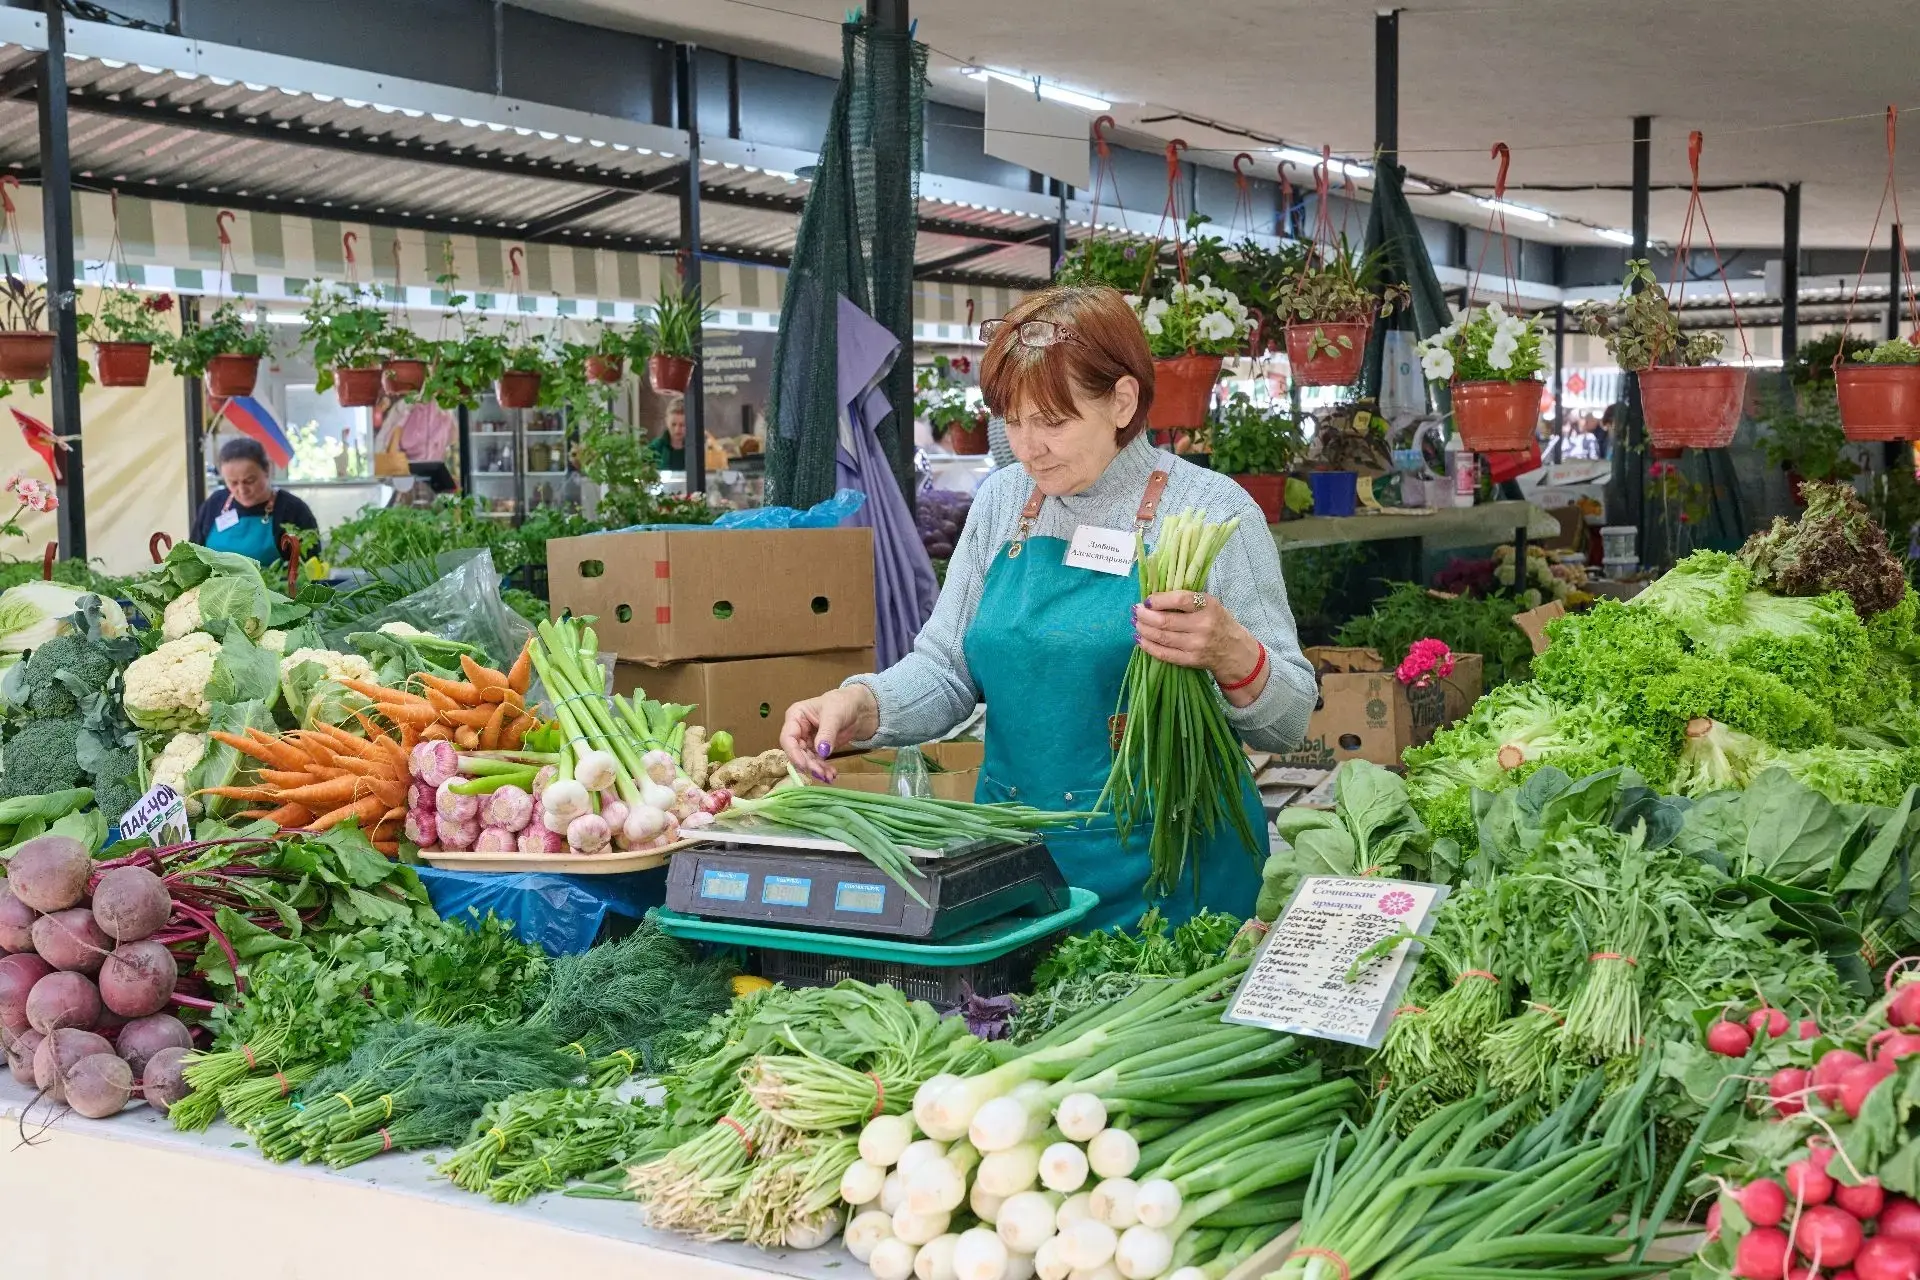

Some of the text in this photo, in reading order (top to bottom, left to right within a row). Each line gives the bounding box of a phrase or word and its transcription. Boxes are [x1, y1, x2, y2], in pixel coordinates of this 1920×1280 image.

[120, 783, 178, 840] ПАК-ЧОЙ
[1312, 887, 1377, 899] Сочинские
[1311, 900, 1363, 911] ярмарки
